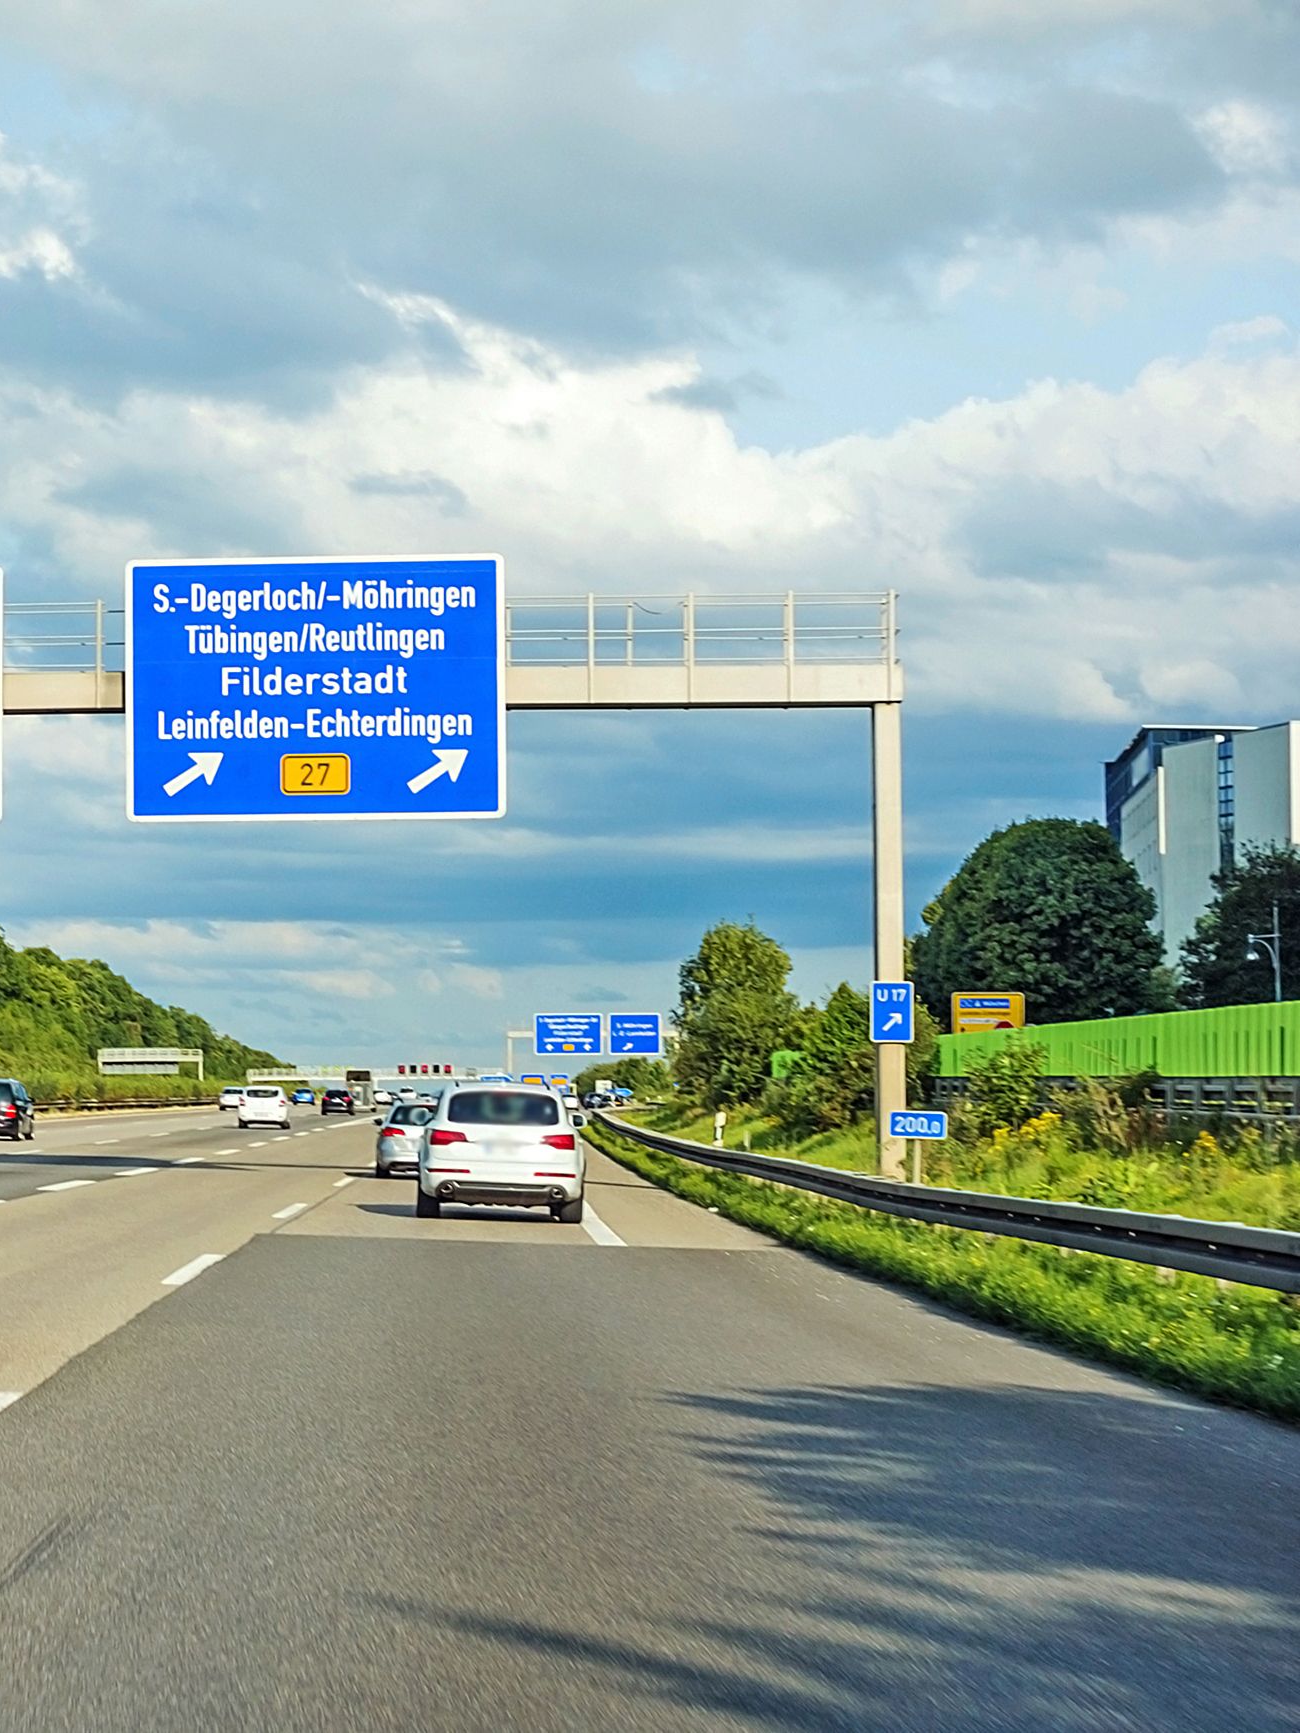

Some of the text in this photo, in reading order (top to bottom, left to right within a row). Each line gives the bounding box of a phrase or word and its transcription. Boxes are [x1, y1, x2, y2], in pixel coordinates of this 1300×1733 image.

[153, 580, 476, 619] S.-Degerloch/-Möhringen
[185, 622, 445, 660] Tübingen/Reutlingen
[221, 665, 408, 696] Filderstadt
[158, 707, 473, 744] Leinfelden-Echterdingen
[300, 763, 330, 786] 27
[877, 988, 907, 1002] U 17
